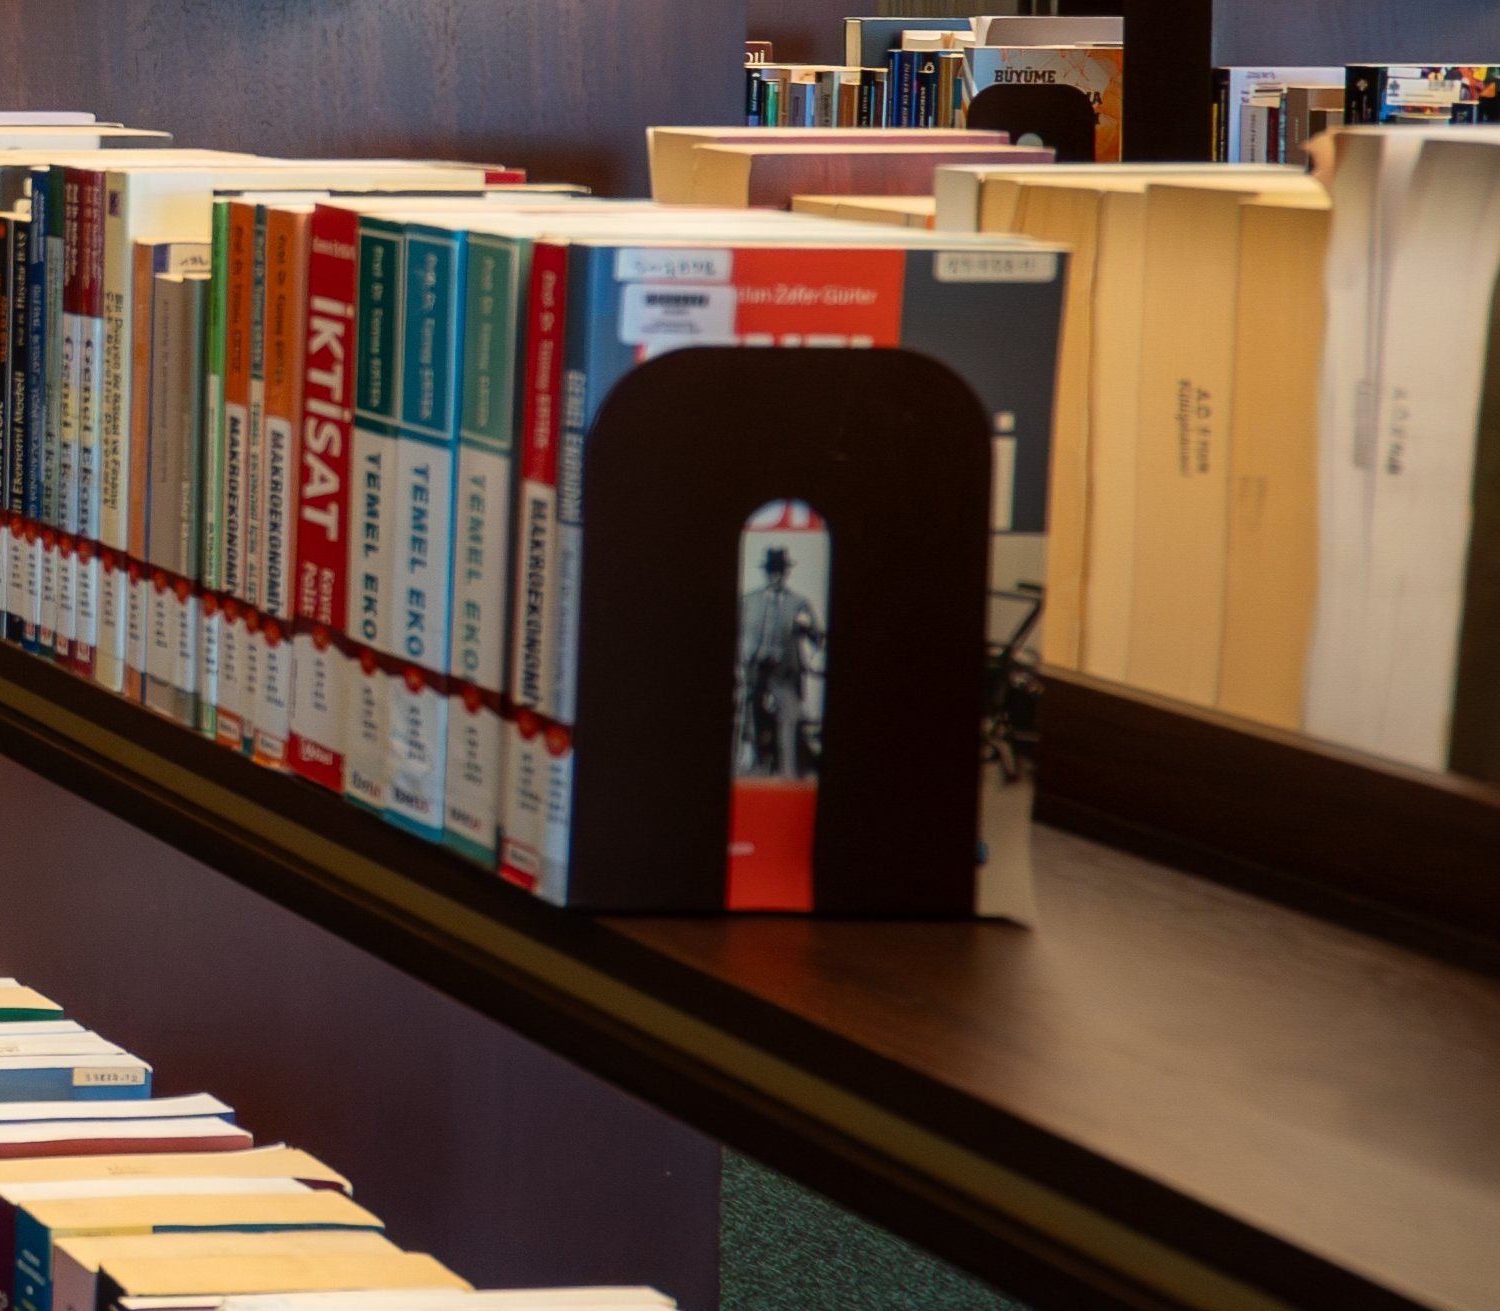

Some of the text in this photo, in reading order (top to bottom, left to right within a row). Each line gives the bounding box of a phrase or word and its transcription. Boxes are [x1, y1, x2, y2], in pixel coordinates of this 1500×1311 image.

[994, 66, 1057, 84] BÜYÜME
[62, 336, 74, 429] Genel
[82, 339, 94, 433] Genel
[301, 295, 354, 542] İKTİSAT
[362, 452, 382, 641] TEMEL EKO
[407, 464, 430, 657] TEMEL EKO
[463, 474, 487, 671] TEMEL EKO
